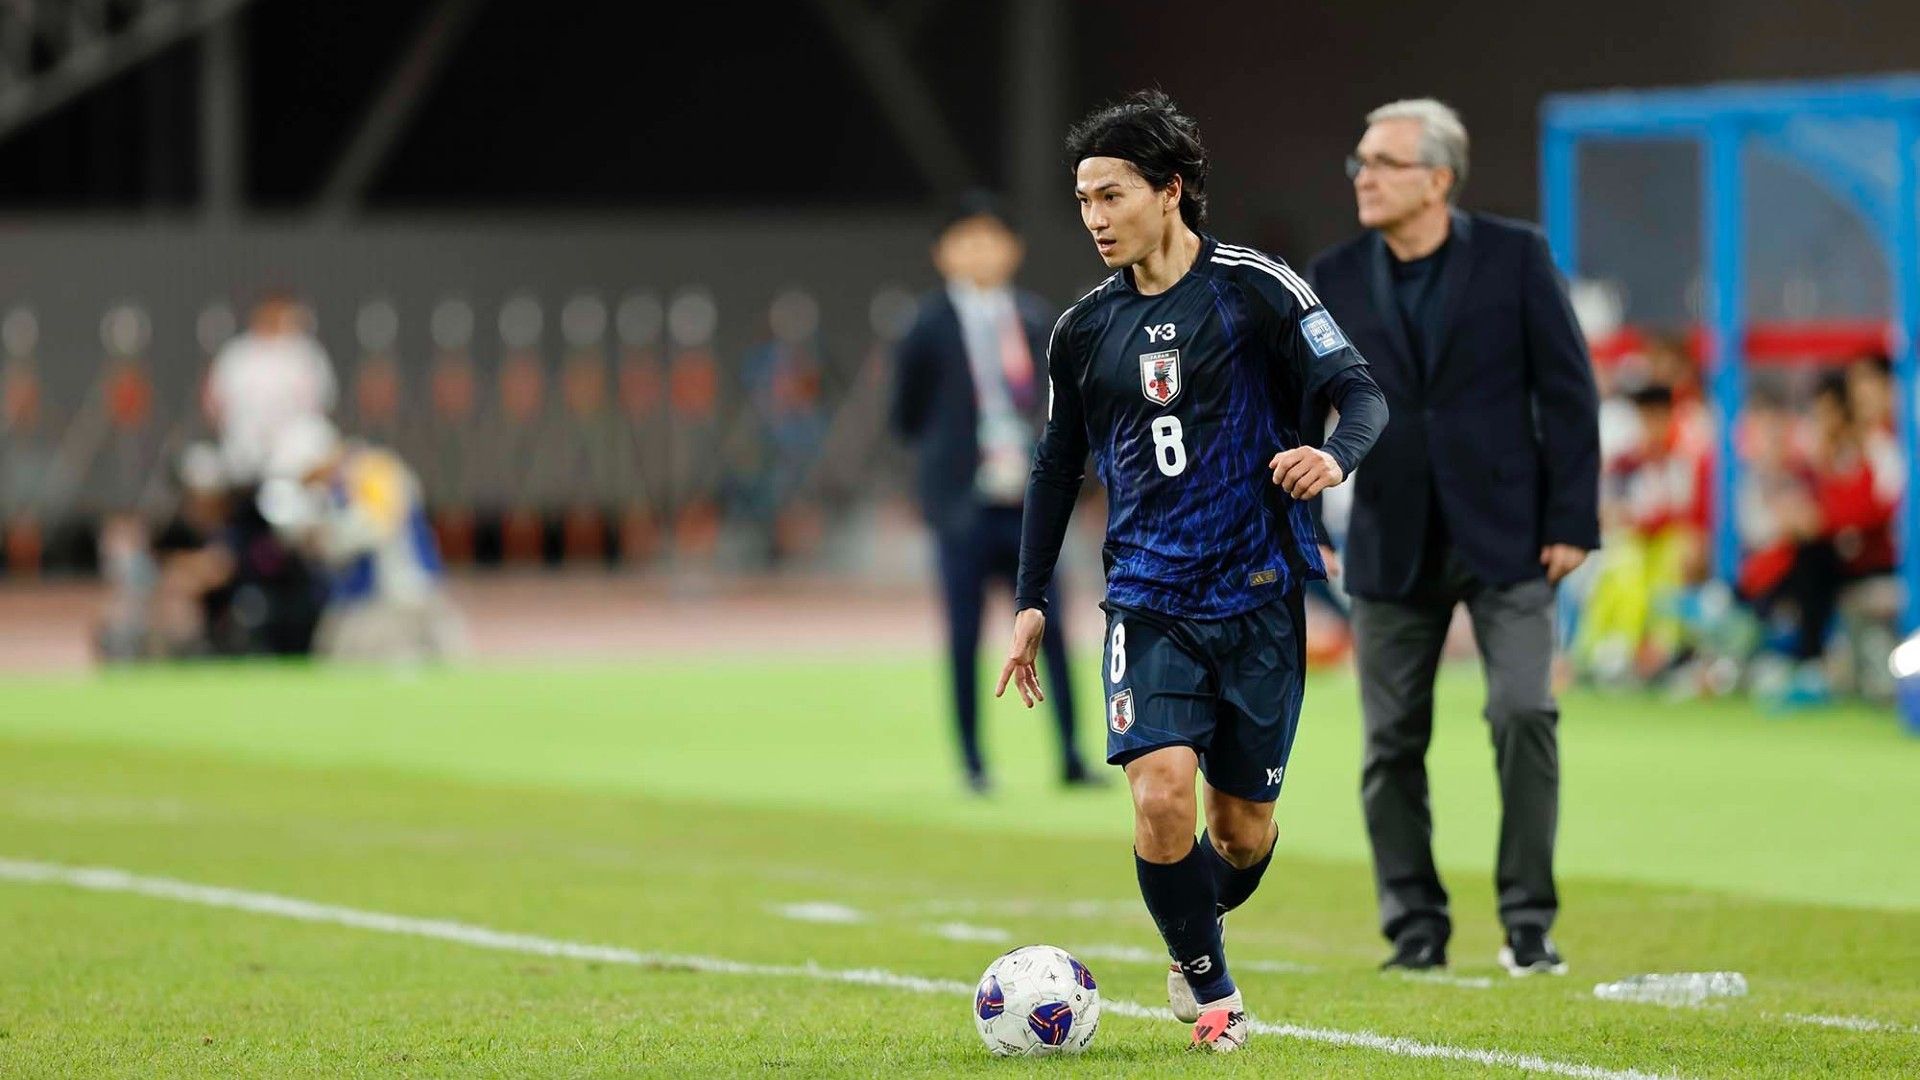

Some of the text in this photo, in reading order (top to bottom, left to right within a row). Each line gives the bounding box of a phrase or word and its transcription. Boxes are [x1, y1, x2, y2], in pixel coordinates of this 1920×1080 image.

[1143, 322, 1176, 343] Y-3
[1150, 353, 1170, 361] JAPAN
[1151, 415, 1187, 477] 8
[1110, 622, 1126, 684] 8
[1266, 766, 1283, 786] Y-3
